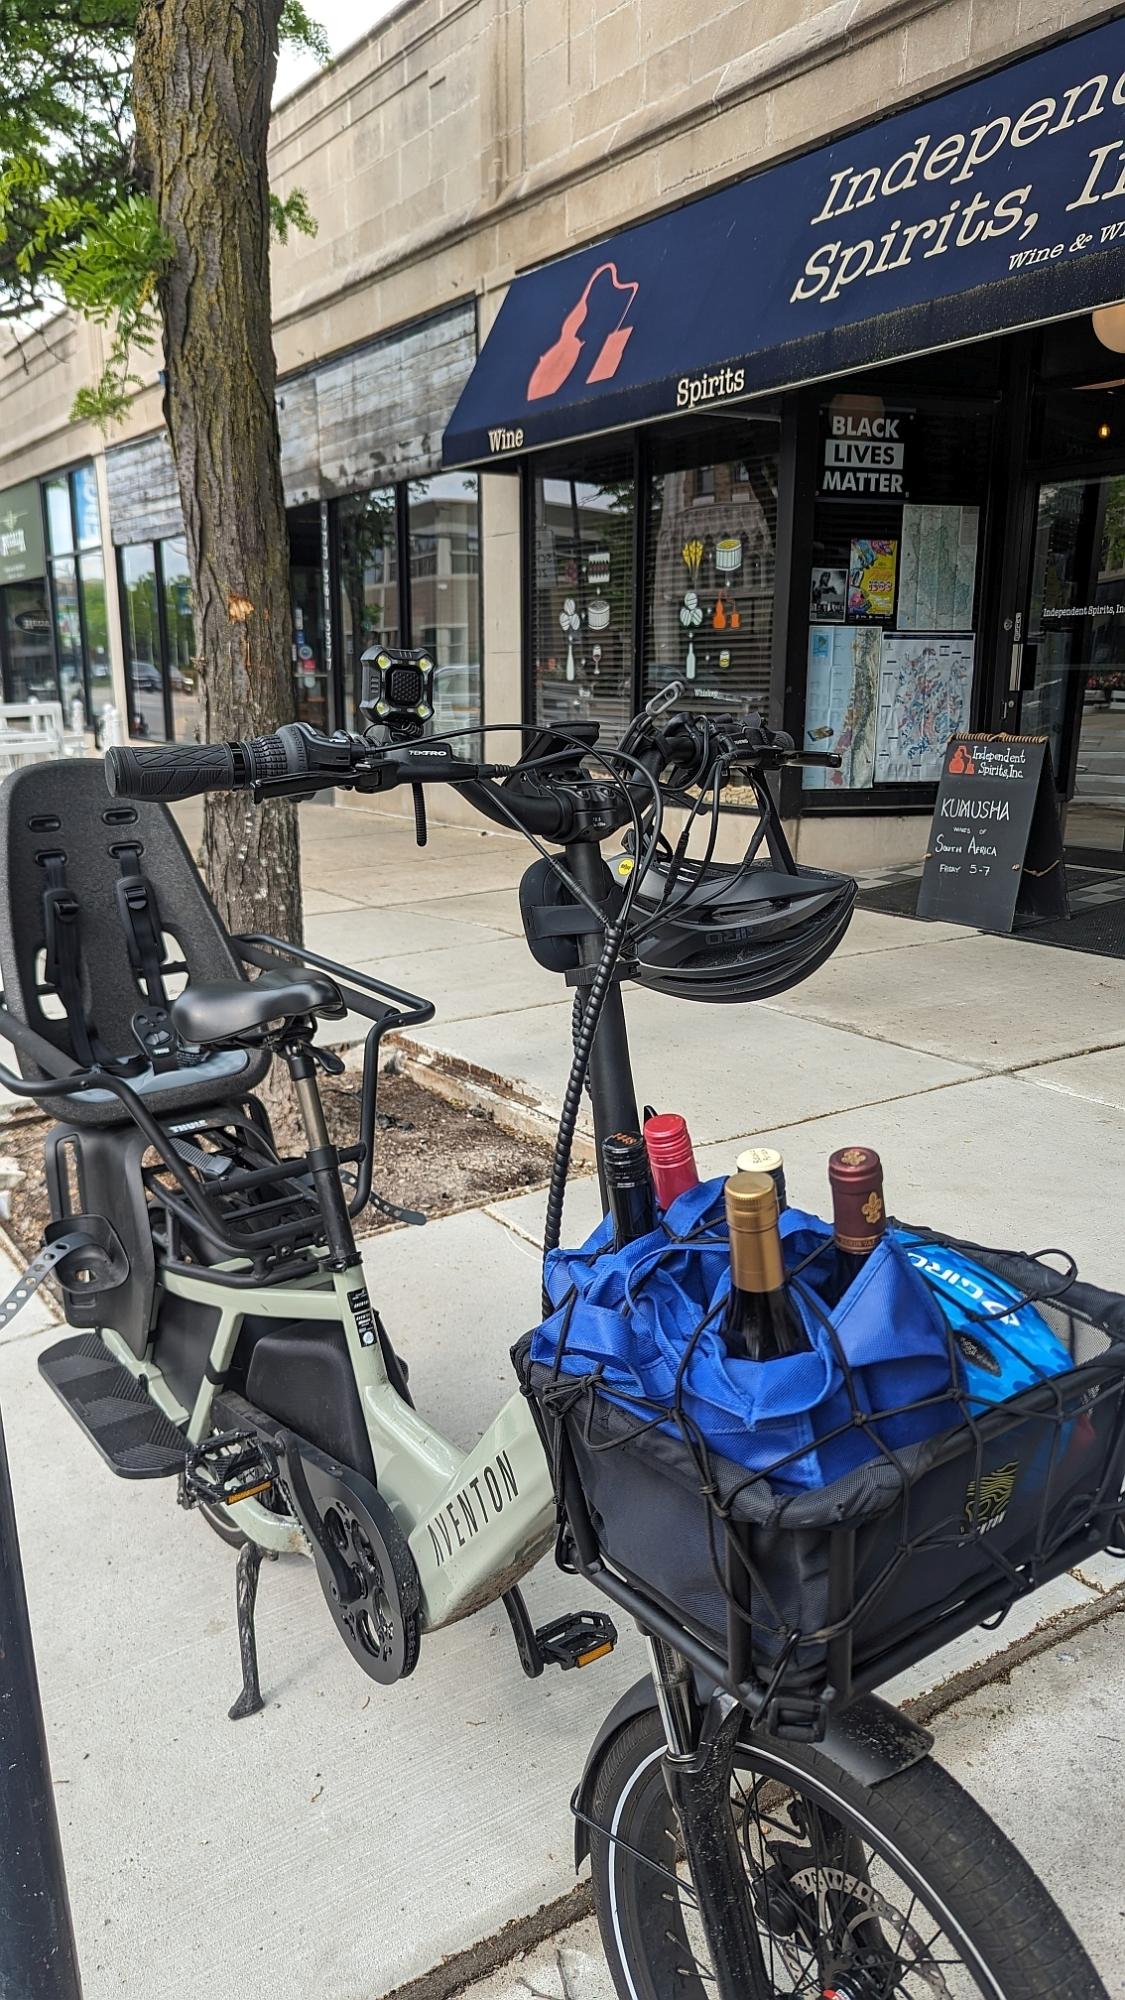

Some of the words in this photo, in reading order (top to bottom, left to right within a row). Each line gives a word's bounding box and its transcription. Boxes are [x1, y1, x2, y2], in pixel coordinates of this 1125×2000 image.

[789, 184, 1040, 304] Spirits,
[1008, 243, 1065, 271] Wine
[1069, 233, 1093, 253] &
[676, 367, 745, 409] Spirits
[832, 415, 900, 439] BLACK
[488, 427, 524, 453] Wine
[833, 442, 895, 466] LIVES
[822, 470, 903, 493] MATTER
[1042, 606, 1087, 619] Independent
[1088, 605, 1115, 617] Spirits,
[408, 749, 447, 757] TEKTRO
[971, 745, 1026, 764] Independent
[940, 798, 1010, 821] KUMUSHA
[427, 1449, 519, 1567] AVENTON
